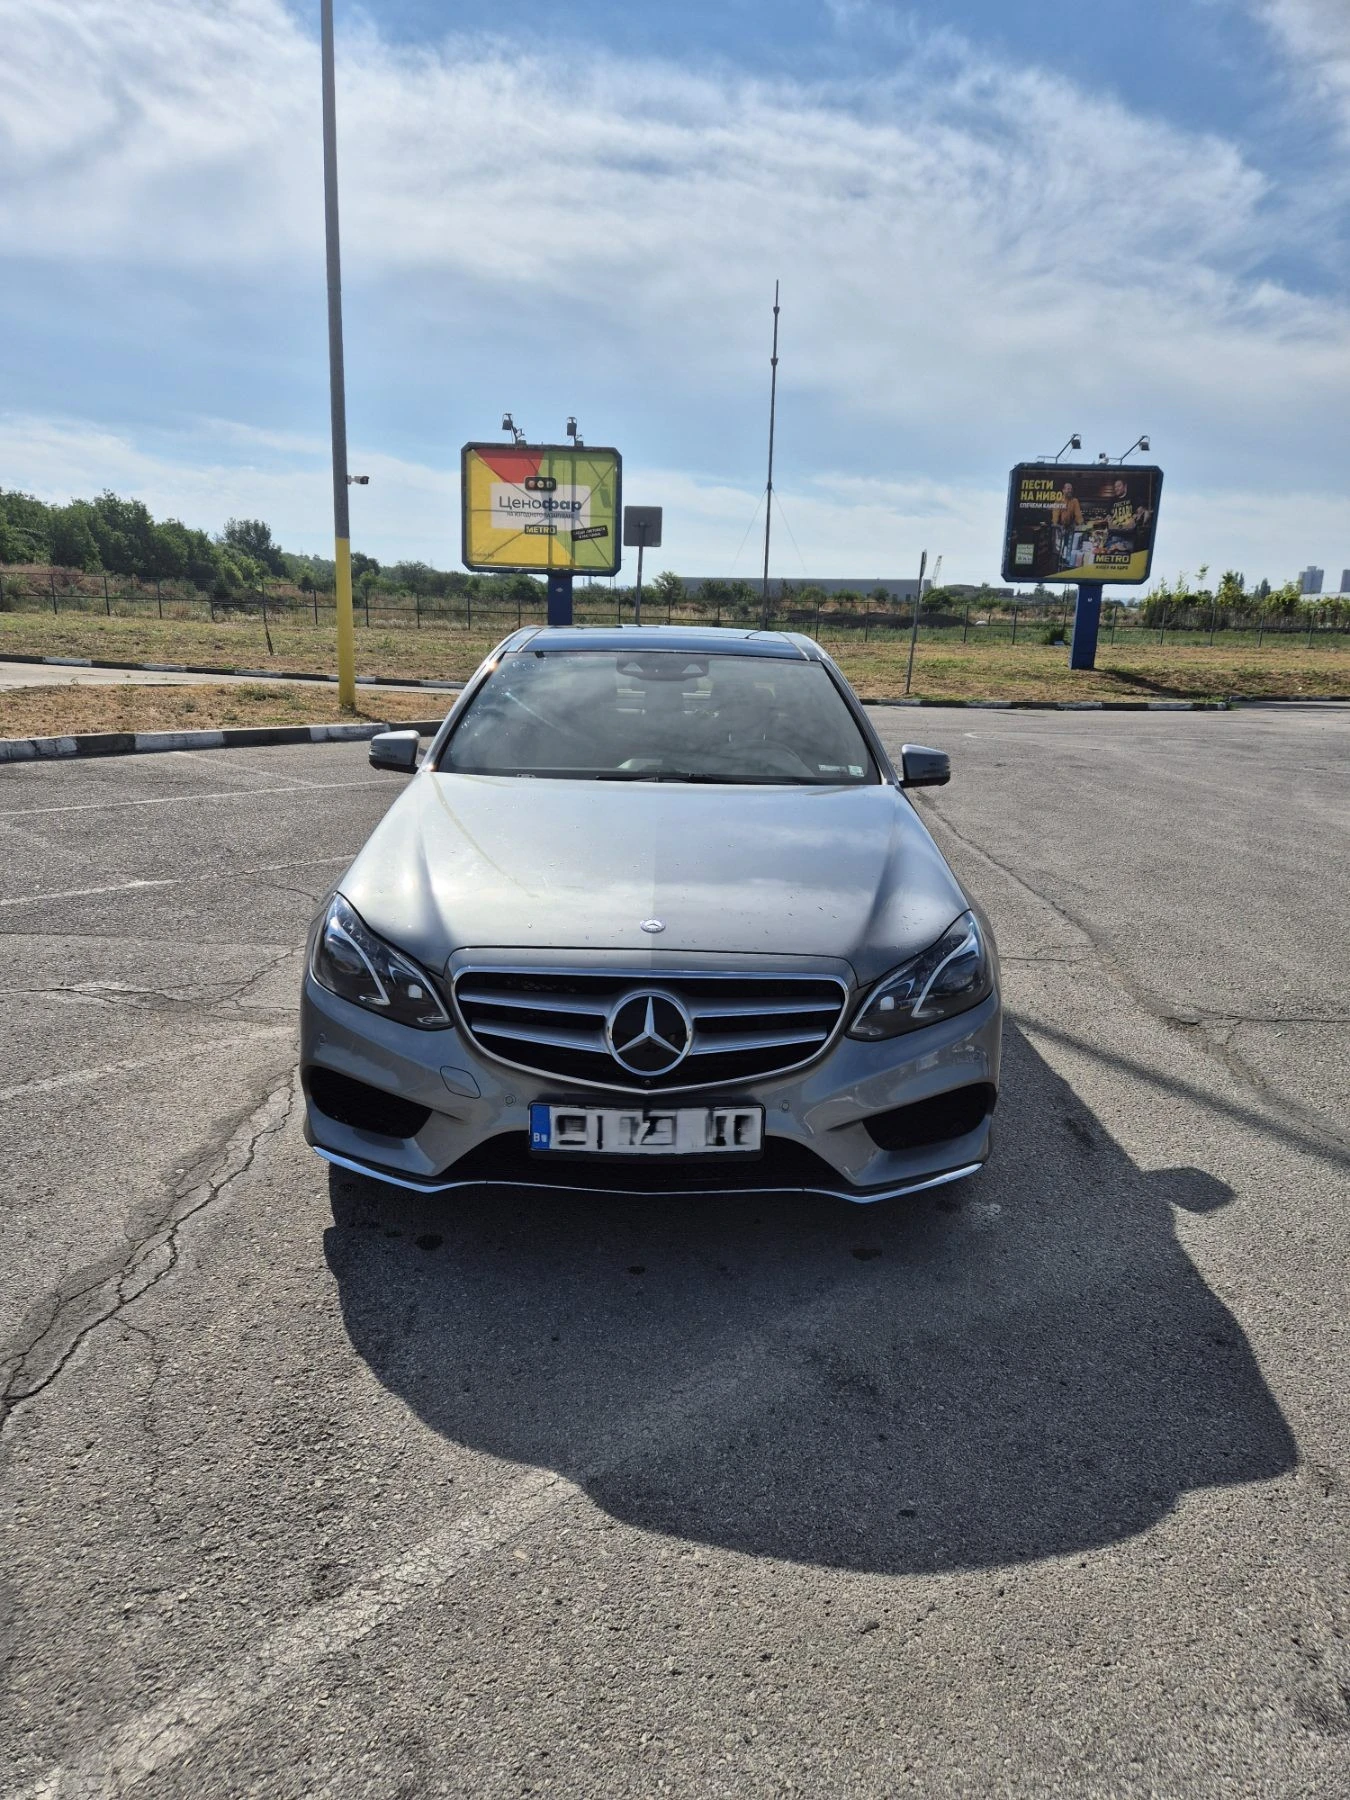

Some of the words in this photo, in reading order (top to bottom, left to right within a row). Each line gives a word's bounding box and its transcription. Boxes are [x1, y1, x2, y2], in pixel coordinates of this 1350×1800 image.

[1021, 480, 1054, 490] ПЕСТИ
[1020, 491, 1034, 501] НА
[499, 496, 582, 512] Ценофар
[526, 525, 556, 534] METRO
[1095, 554, 1130, 563] METRO
